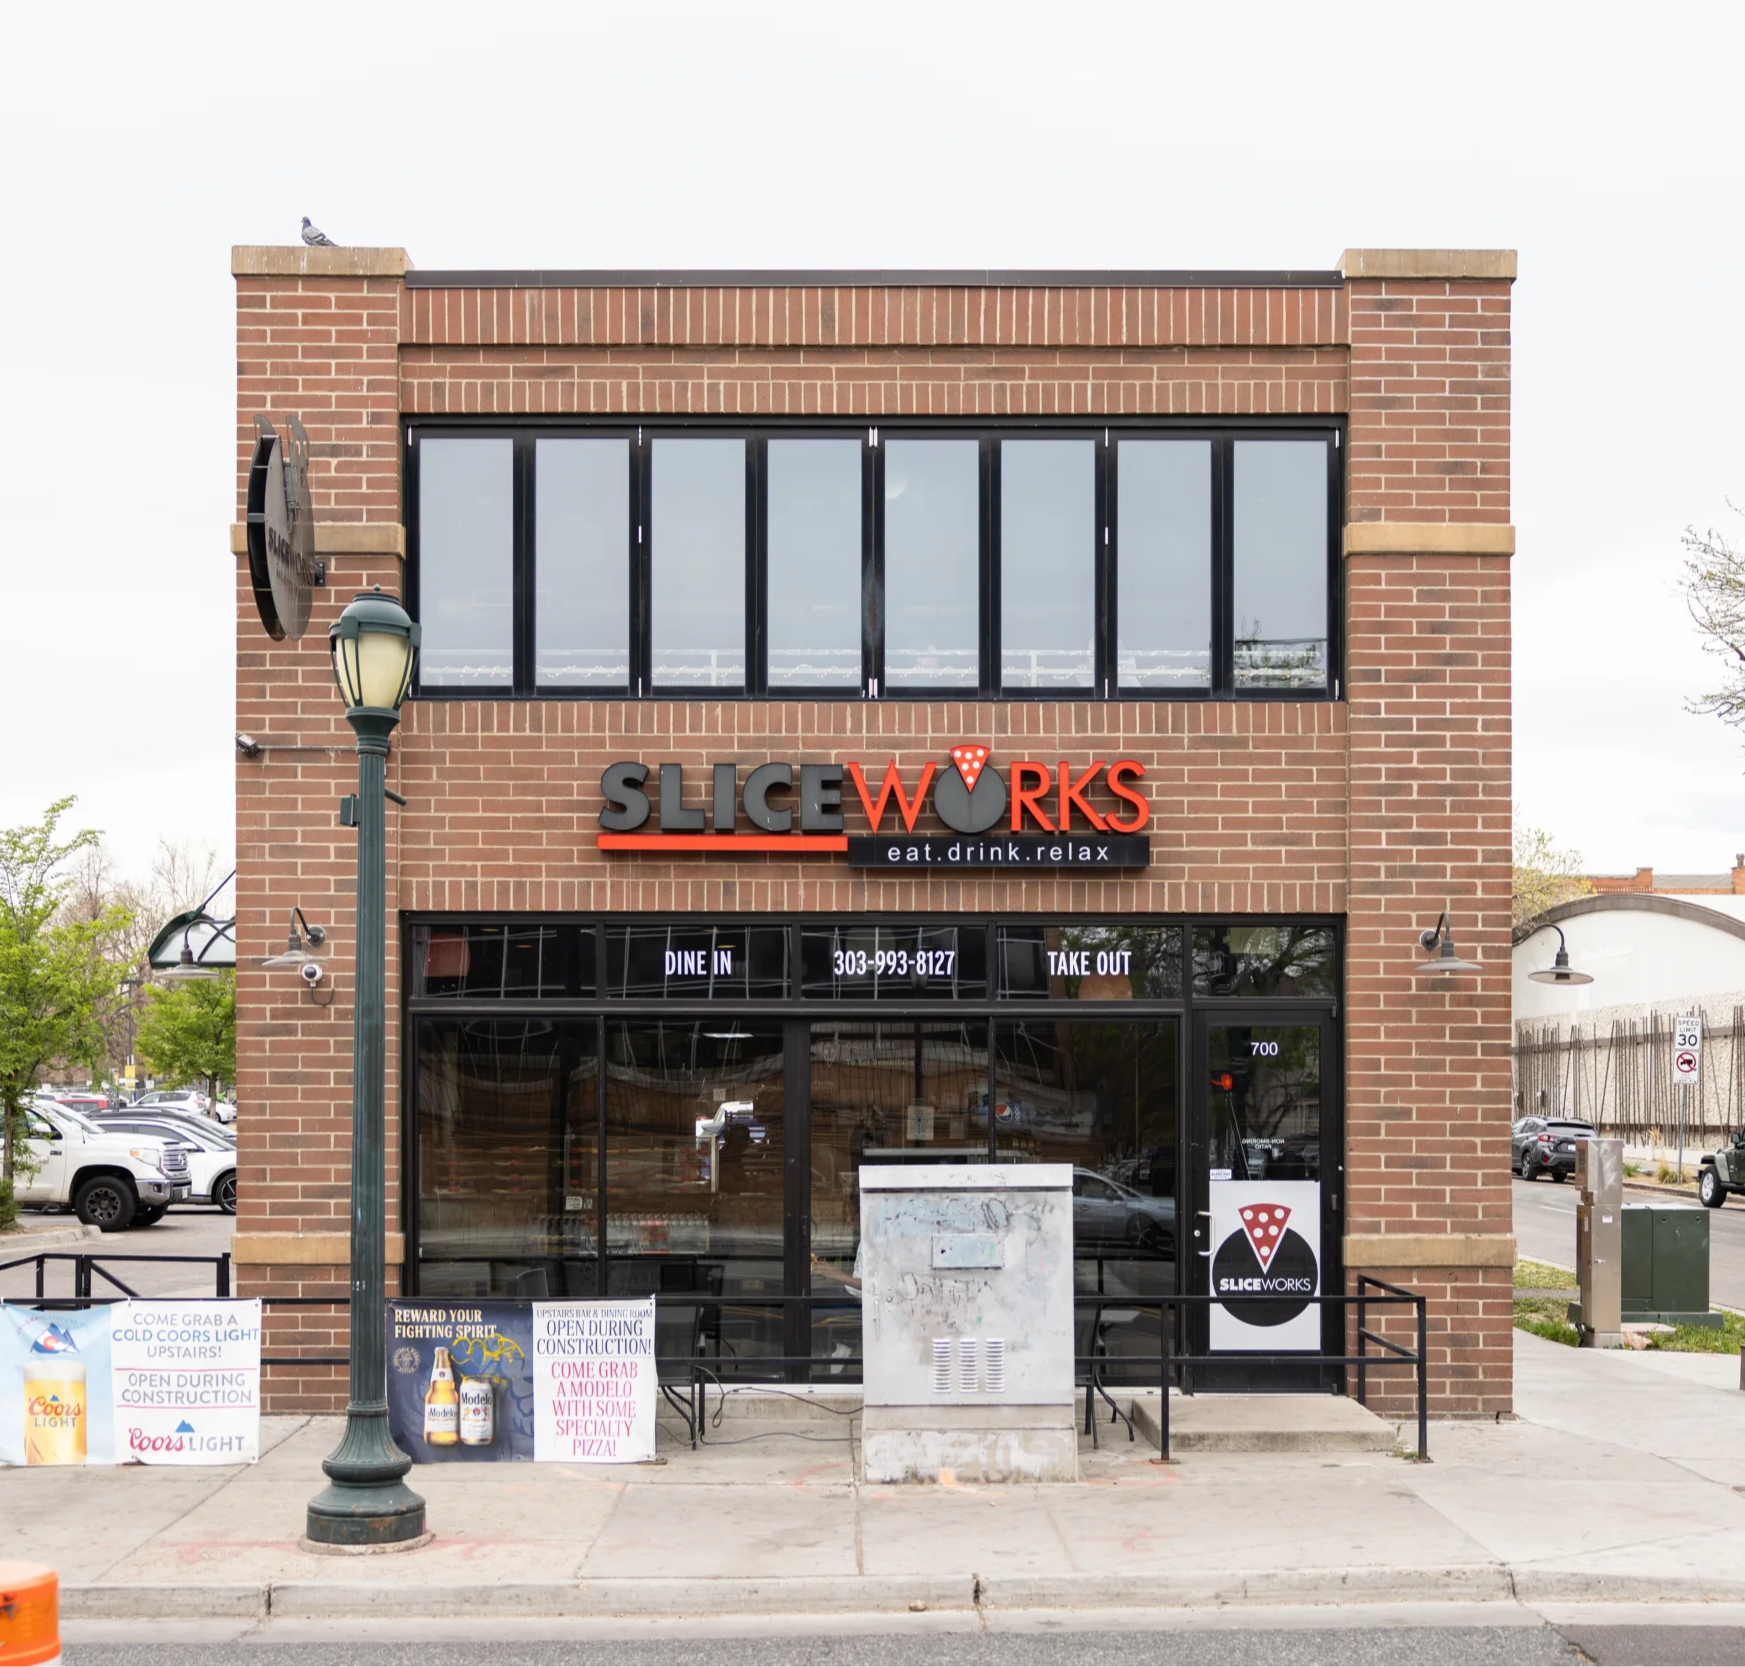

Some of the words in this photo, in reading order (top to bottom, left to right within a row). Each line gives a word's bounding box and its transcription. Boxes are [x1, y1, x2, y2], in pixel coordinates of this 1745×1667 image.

[887, 843, 1110, 863] eat.drink.relax
[664, 950, 707, 976] DINE
[712, 951, 732, 976] IN
[833, 950, 956, 977] 303-993-8127
[1047, 951, 1091, 976] TAKE
[1096, 951, 1132, 976] OUT
[1678, 1033, 1698, 1047] 30
[1250, 1042, 1279, 1056] 700
[1219, 1277, 1312, 1292] SLICEWORKS
[133, 1313, 178, 1327] COME
[183, 1313, 223, 1327] GRAB
[227, 1313, 238, 1326] A
[394, 1309, 446, 1324] REWARD
[449, 1309, 482, 1323] YOUR
[536, 1309, 575, 1319] UPSTAIRS
[575, 1309, 592, 1319] BAR
[592, 1309, 599, 1318] &
[600, 1309, 626, 1318] DINING
[627, 1309, 653, 1318] ROOM
[112, 1329, 153, 1342] COLD
[157, 1329, 210, 1342] COORS
[215, 1328, 260, 1342] LIGHT
[394, 1324, 453, 1339] FIGHTING
[456, 1324, 497, 1339] SPIRIT
[546, 1320, 585, 1337] OPEN
[588, 1319, 643, 1337] DURING
[147, 1345, 222, 1359] UPSTAIRS!
[536, 1338, 652, 1356] CONSTRUCTION!
[551, 1361, 595, 1379] COME
[598, 1361, 638, 1378] GRAB
[128, 1373, 171, 1388] OPEN
[177, 1373, 245, 1388] DURING
[121, 1389, 252, 1404] CONSTRUCTION
[556, 1381, 566, 1398] A
[570, 1380, 633, 1398] MODELO
[462, 1391, 492, 1406] Modelo
[28, 1397, 82, 1417] Coors
[429, 1407, 456, 1418] Modelo
[552, 1400, 592, 1419] WITH
[596, 1400, 637, 1418] SOME
[34, 1417, 77, 1428] LIGHT
[555, 1420, 633, 1437] SPECIALTY
[128, 1427, 185, 1452] Coors
[189, 1436, 245, 1452] LIGHT
[572, 1439, 617, 1457] PIZZA!
